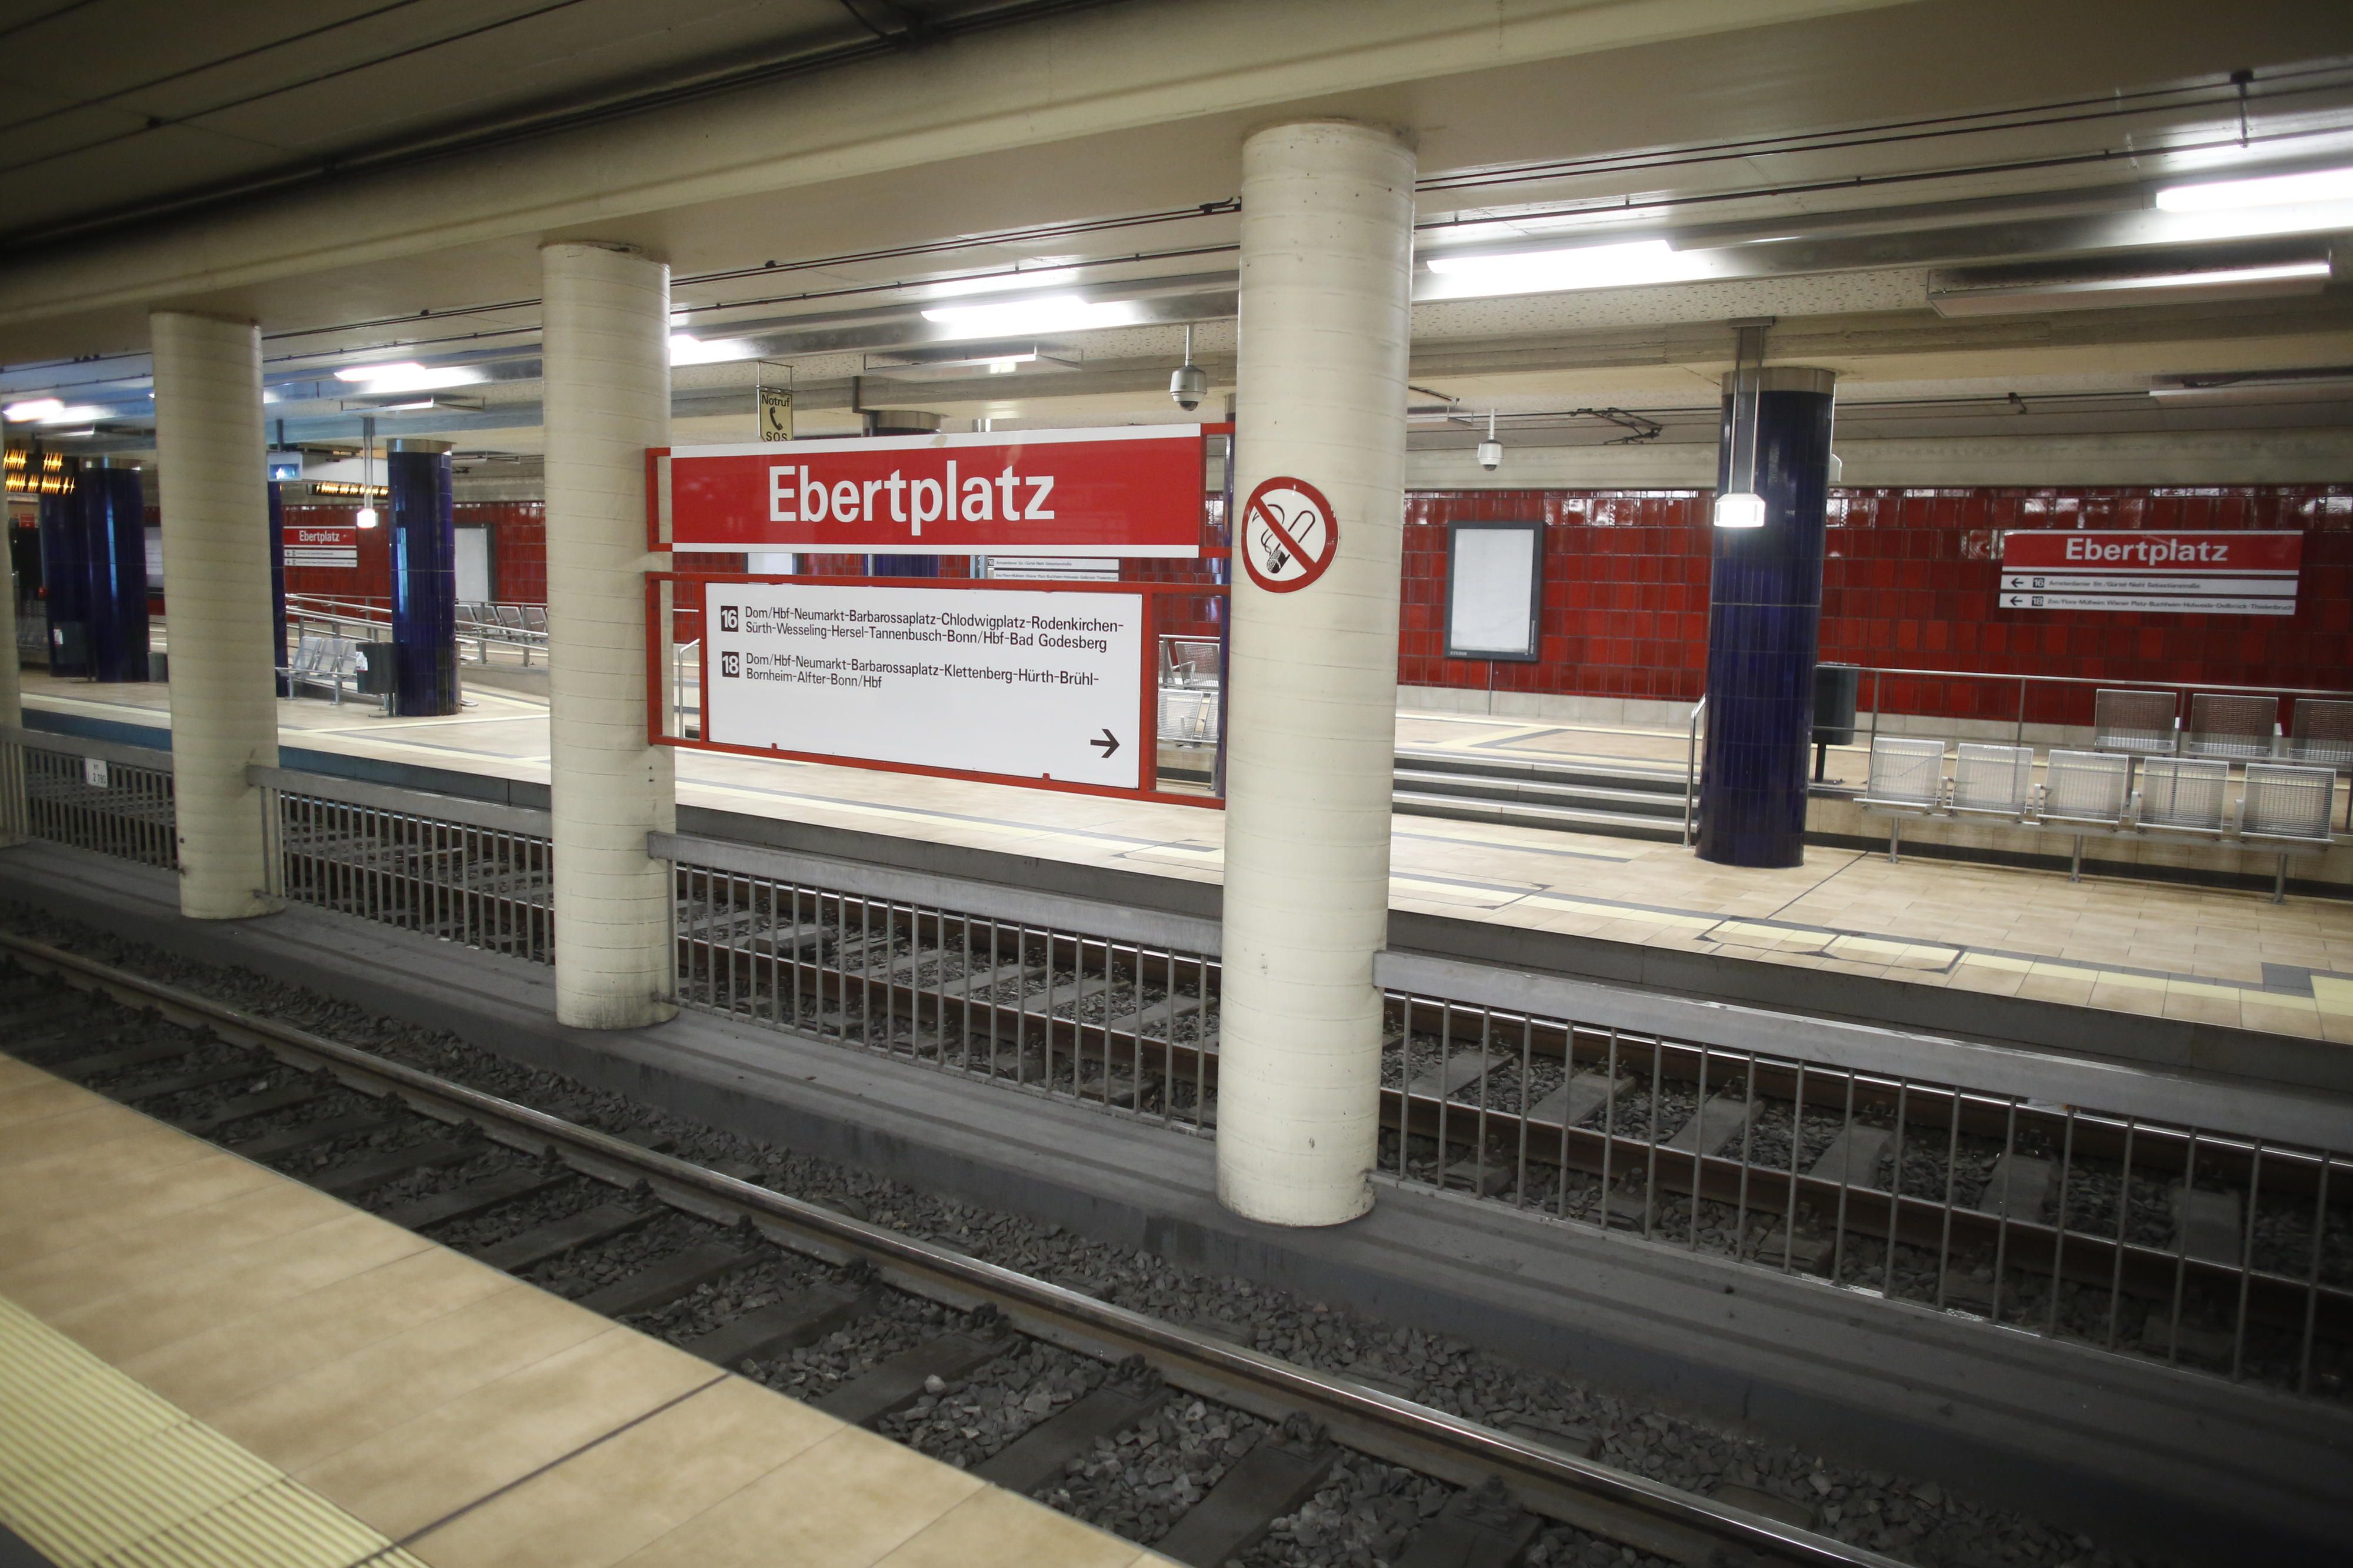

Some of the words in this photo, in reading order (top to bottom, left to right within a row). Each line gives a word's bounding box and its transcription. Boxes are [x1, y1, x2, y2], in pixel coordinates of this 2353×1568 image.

[761, 394, 790, 407] Notruf
[766, 431, 787, 442] SOS
[769, 460, 1055, 536] Ebertplatz
[299, 530, 339, 544] Ebertplatz
[2066, 538, 2228, 566] Ebertplatz
[2034, 578, 2044, 588] 16
[2032, 596, 2043, 606] 18
[721, 609, 738, 629] 16
[1038, 633, 1107, 653] Godesberg
[722, 655, 739, 675] 18
[746, 668, 882, 688] Bornheim-Alfter-Bonn/Hbf
